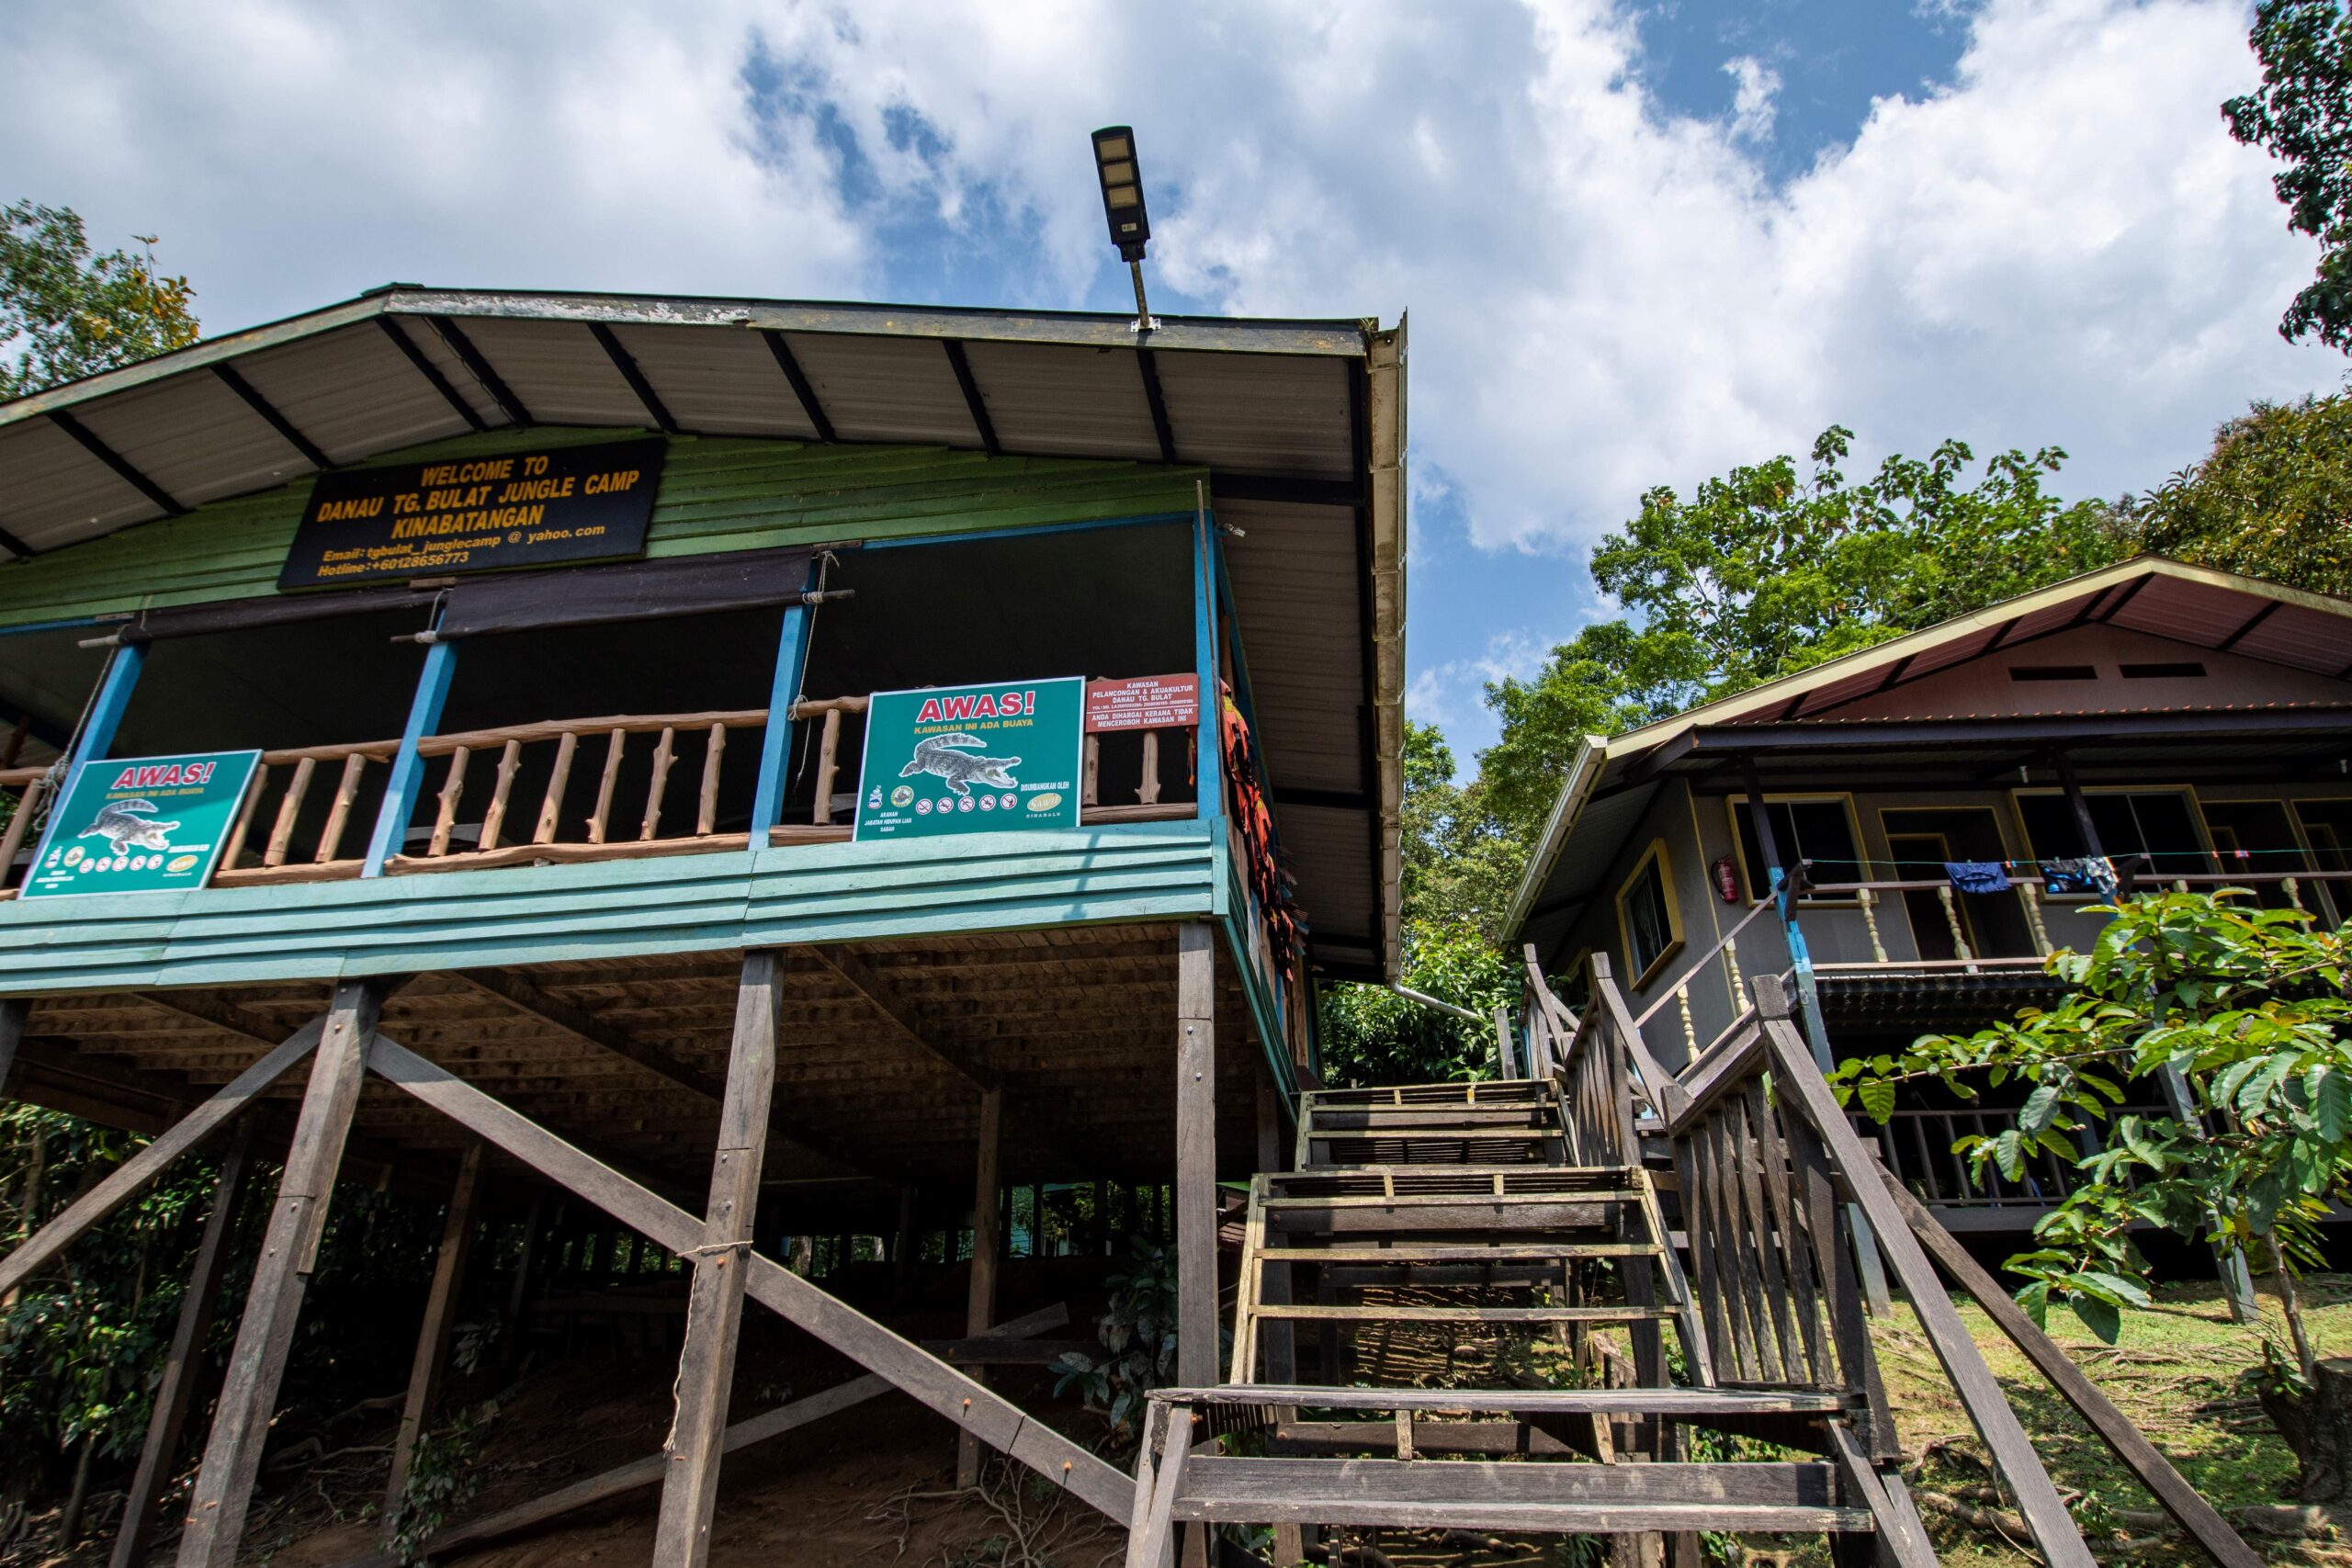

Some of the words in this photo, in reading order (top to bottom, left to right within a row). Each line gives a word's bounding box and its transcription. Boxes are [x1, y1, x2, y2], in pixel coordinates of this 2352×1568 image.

[421, 459, 514, 487] WELCOME
[525, 456, 548, 476] TO
[316, 497, 384, 523] DANAU
[393, 493, 422, 514] TG.
[425, 486, 492, 511] BULAT
[498, 477, 575, 503] JUNGLE
[584, 470, 639, 495] CAMP
[390, 505, 545, 539] KINABATANGAN
[1092, 689, 1139, 698] PELANCONGAN
[1150, 685, 1193, 694] AKUAKULTUR
[916, 691, 1035, 723] AWAS!
[914, 724, 962, 734] KAWASAN
[979, 721, 1000, 729] ADA
[1002, 719, 1034, 728] BUAYA
[1098, 718, 1140, 728] MENCEROBOH
[110, 761, 217, 790] AWAS!
[1057, 781, 1069, 789] OLEH
